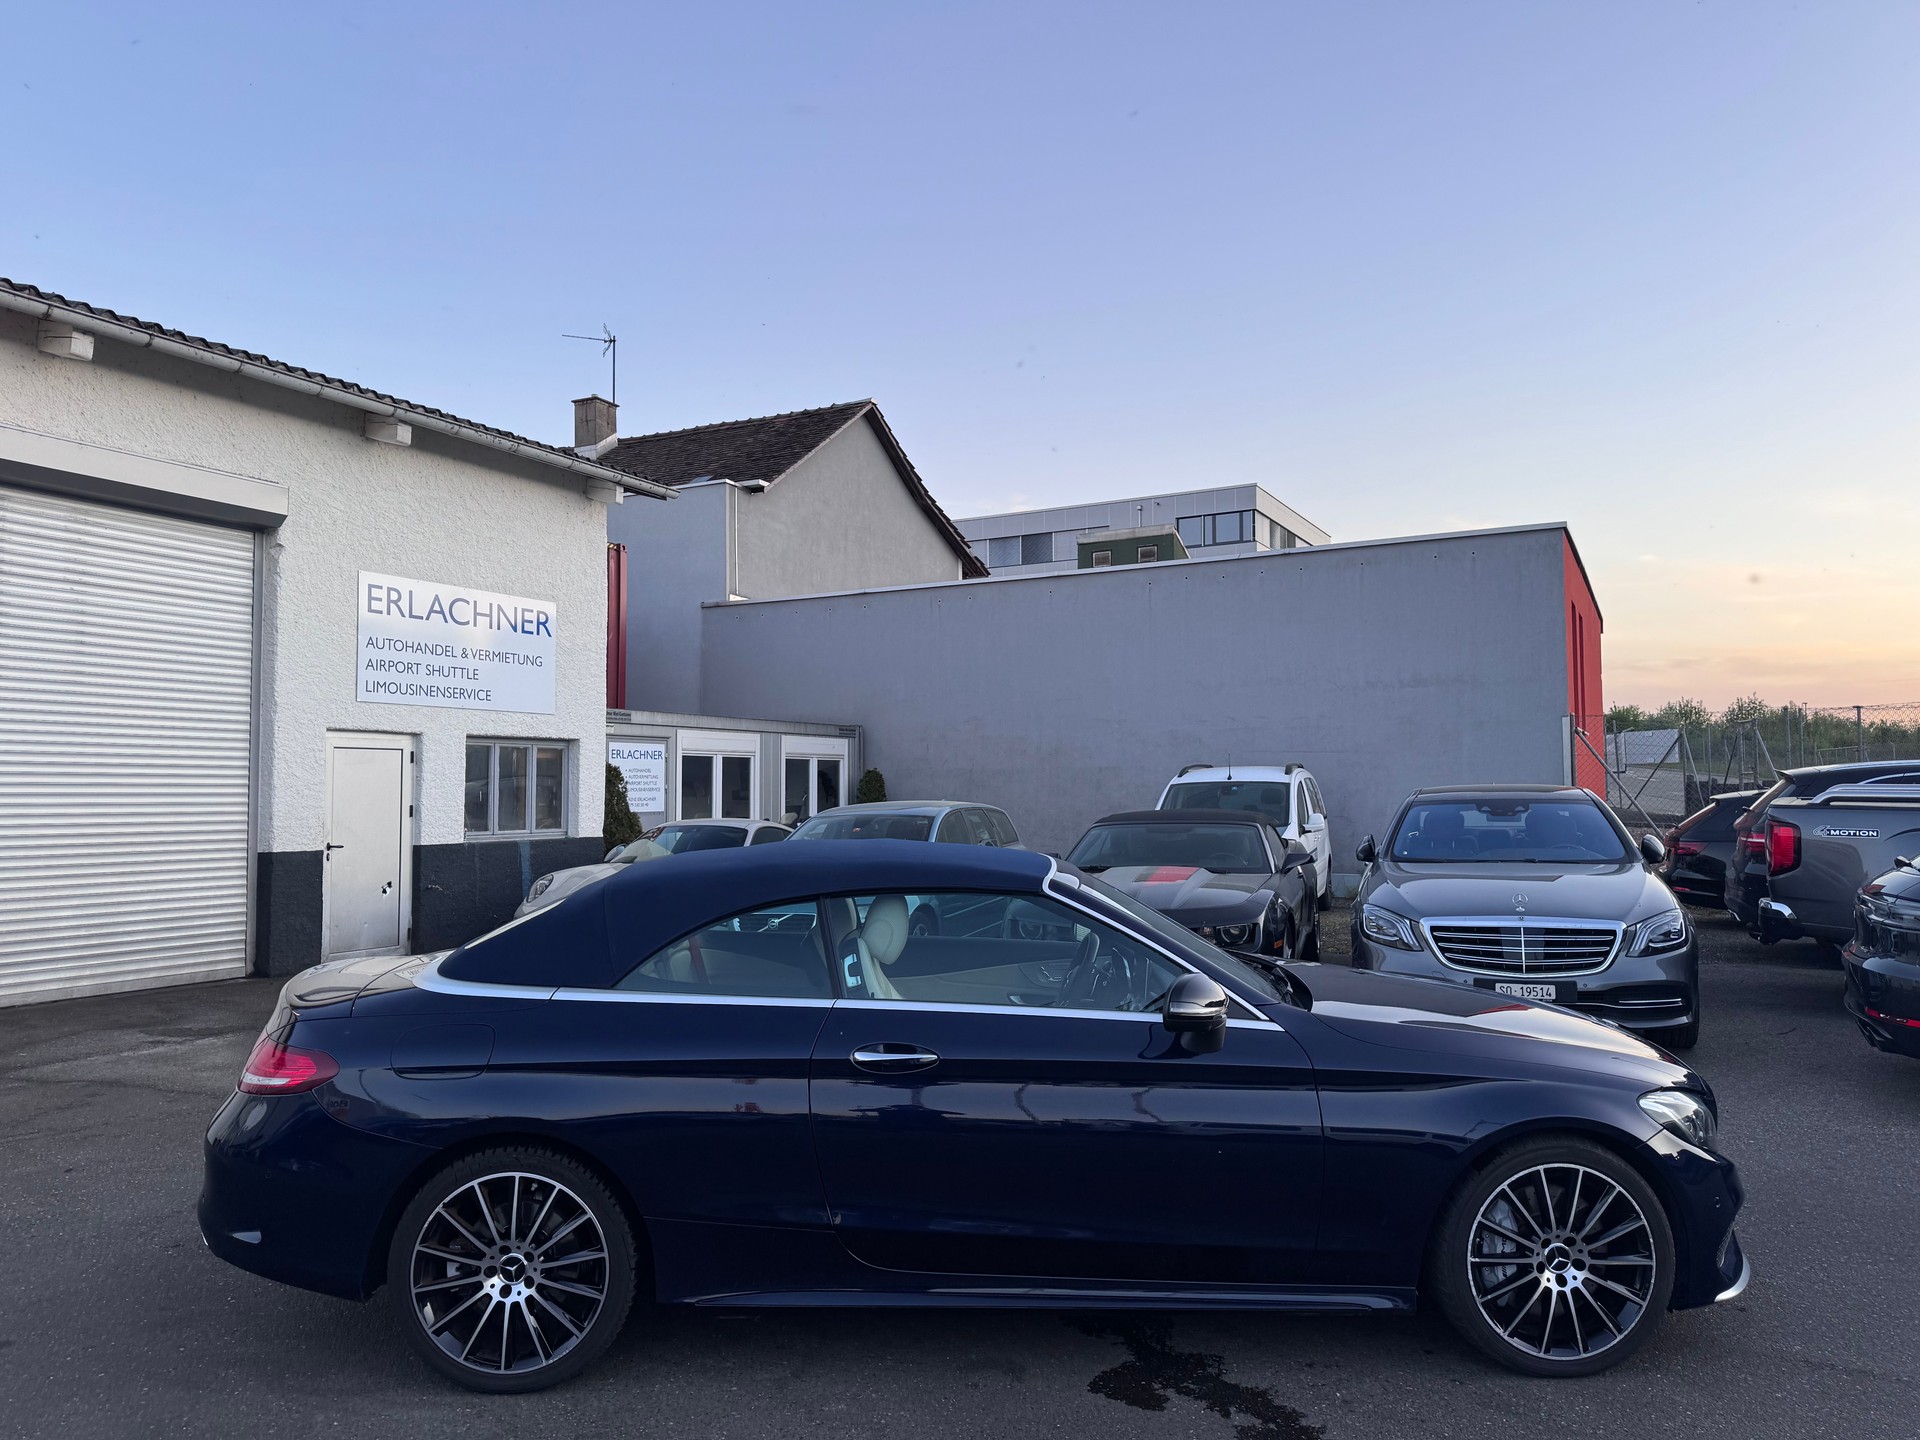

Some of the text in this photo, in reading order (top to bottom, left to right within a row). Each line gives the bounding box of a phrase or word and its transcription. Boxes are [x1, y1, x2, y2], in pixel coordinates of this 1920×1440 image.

[367, 583, 553, 638] ERLACHNER
[365, 636, 543, 667] AUTOHANDEL & VERMIETUNG
[365, 658, 479, 681] AIRPORT SHUTTLE
[365, 680, 492, 702] LIMOUSINENSERVICE
[611, 749, 663, 760] ERLACHNER
[1520, 986, 1552, 998] 19514
